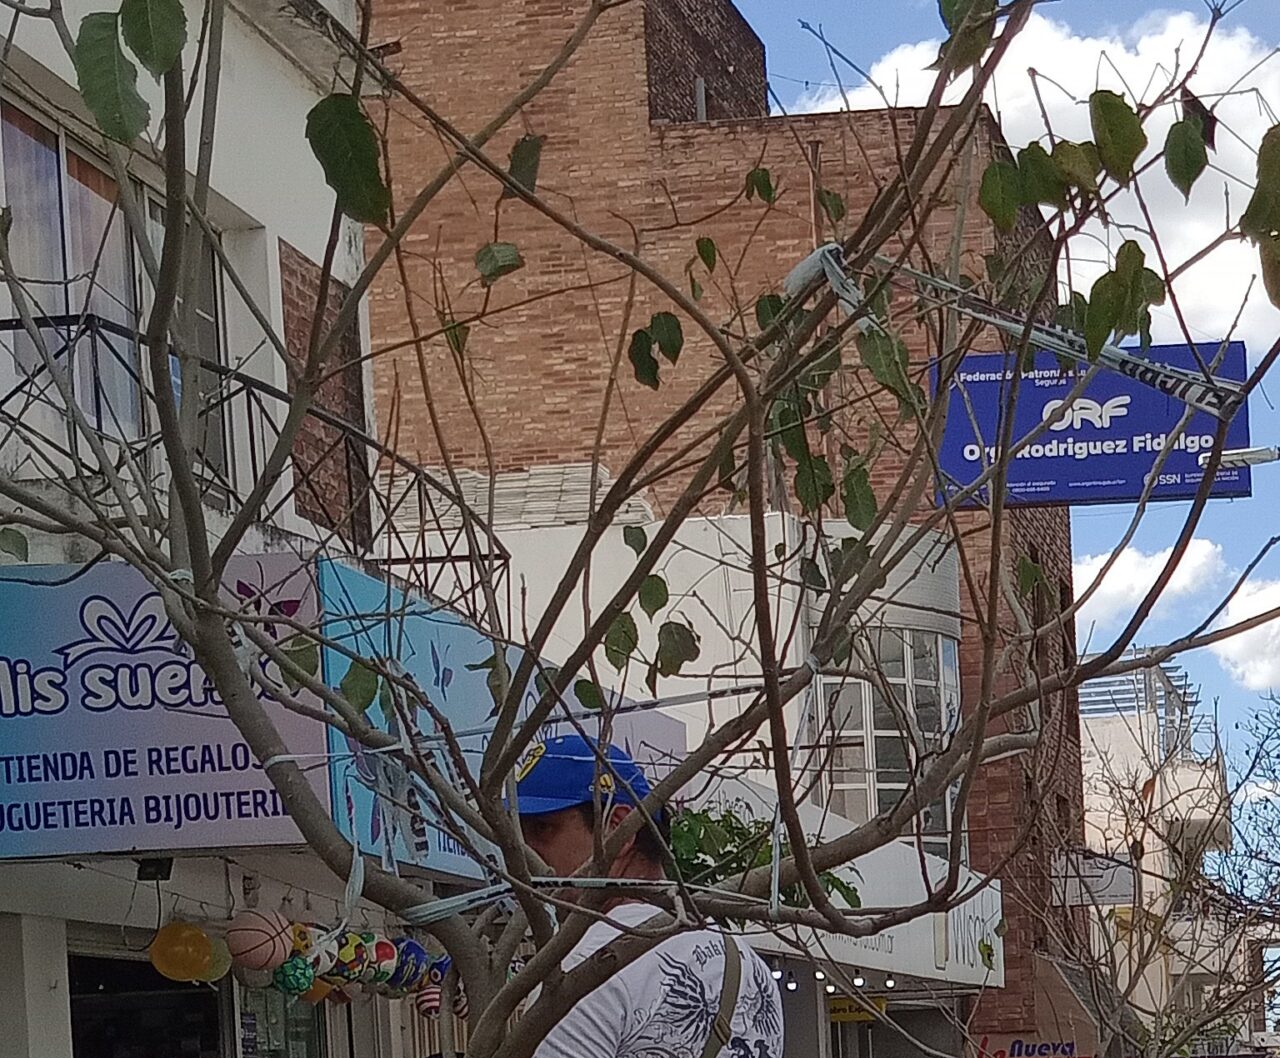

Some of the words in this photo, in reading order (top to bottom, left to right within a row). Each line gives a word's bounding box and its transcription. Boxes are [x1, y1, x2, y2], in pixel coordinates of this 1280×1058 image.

[1042, 395, 1131, 431] ORF
[1133, 432, 1214, 452] Fidlgo
[1159, 474, 1181, 484] SSN
[2, 751, 95, 784] TIENDA
[104, 749, 138, 778] DE
[148, 742, 264, 776] REGALO
[144, 789, 292, 829] BIJOUTERI
[1009, 1039, 1075, 1057] Nueva
